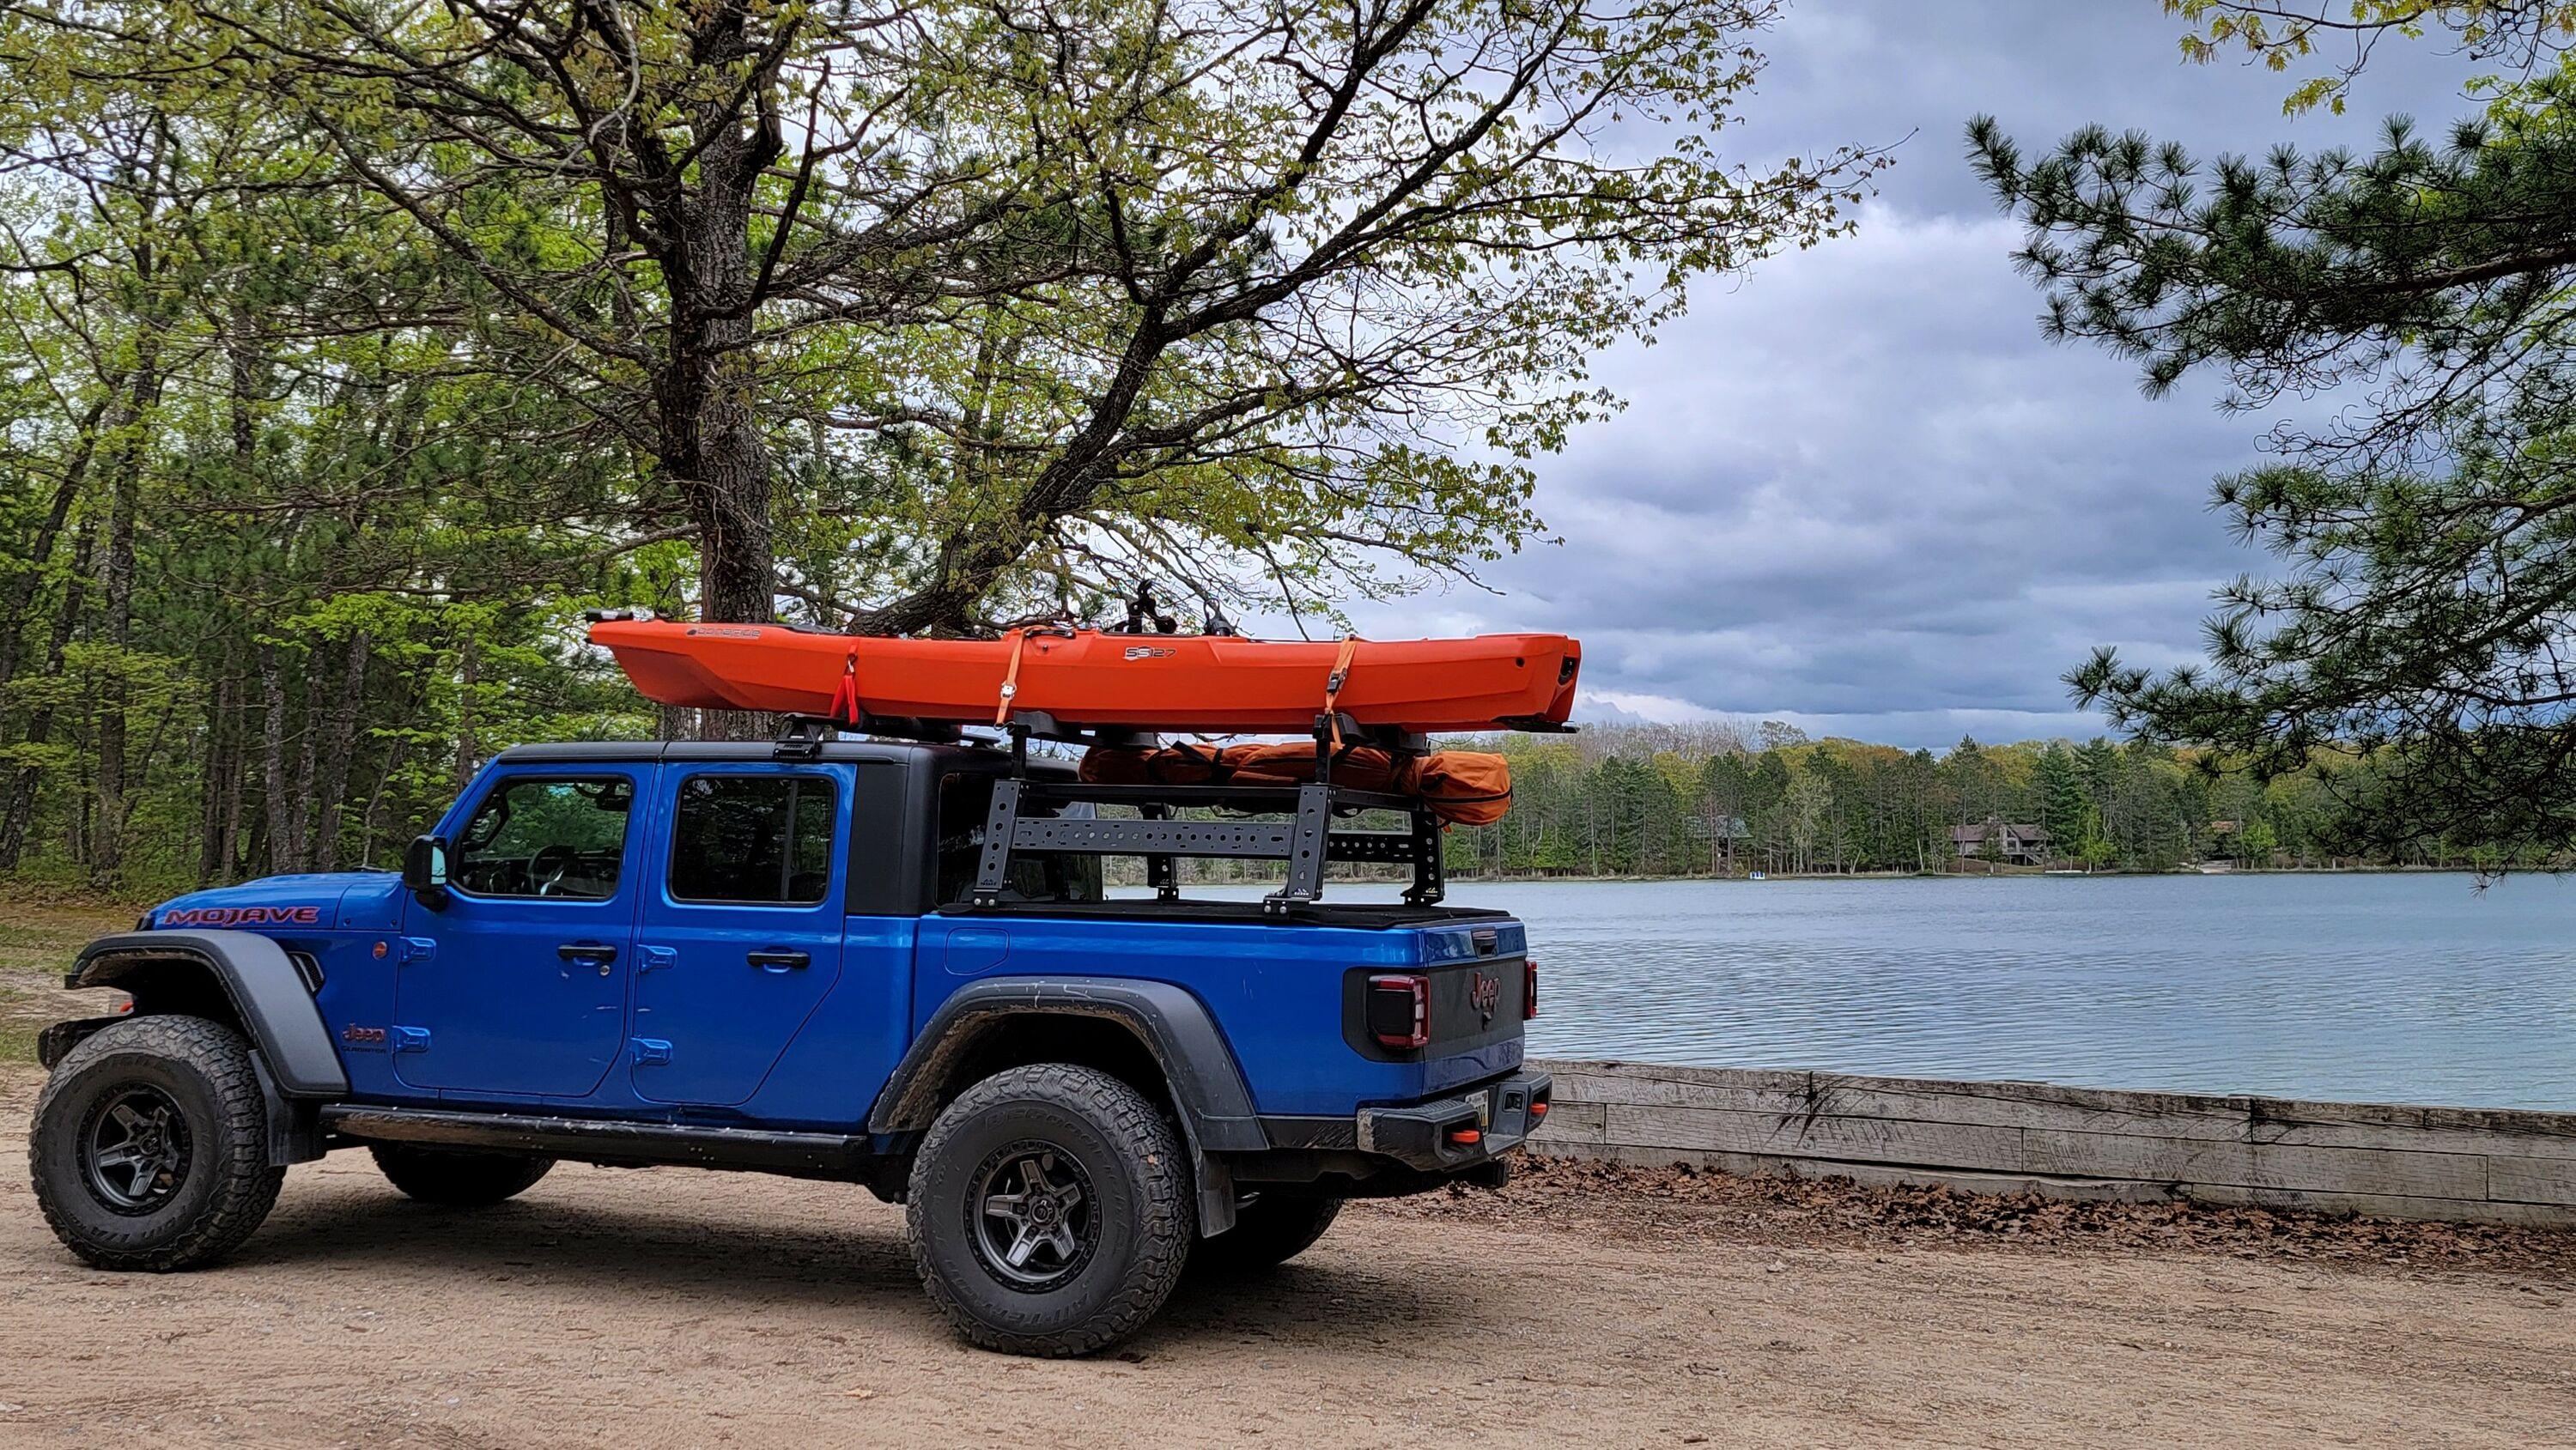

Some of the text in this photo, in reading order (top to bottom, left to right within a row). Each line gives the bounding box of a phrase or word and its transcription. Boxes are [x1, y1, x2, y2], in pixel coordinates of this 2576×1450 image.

[164, 907, 321, 927] MOJAVE
[1471, 972, 1501, 1015] Jeep
[343, 1022, 386, 1043] Jeep
